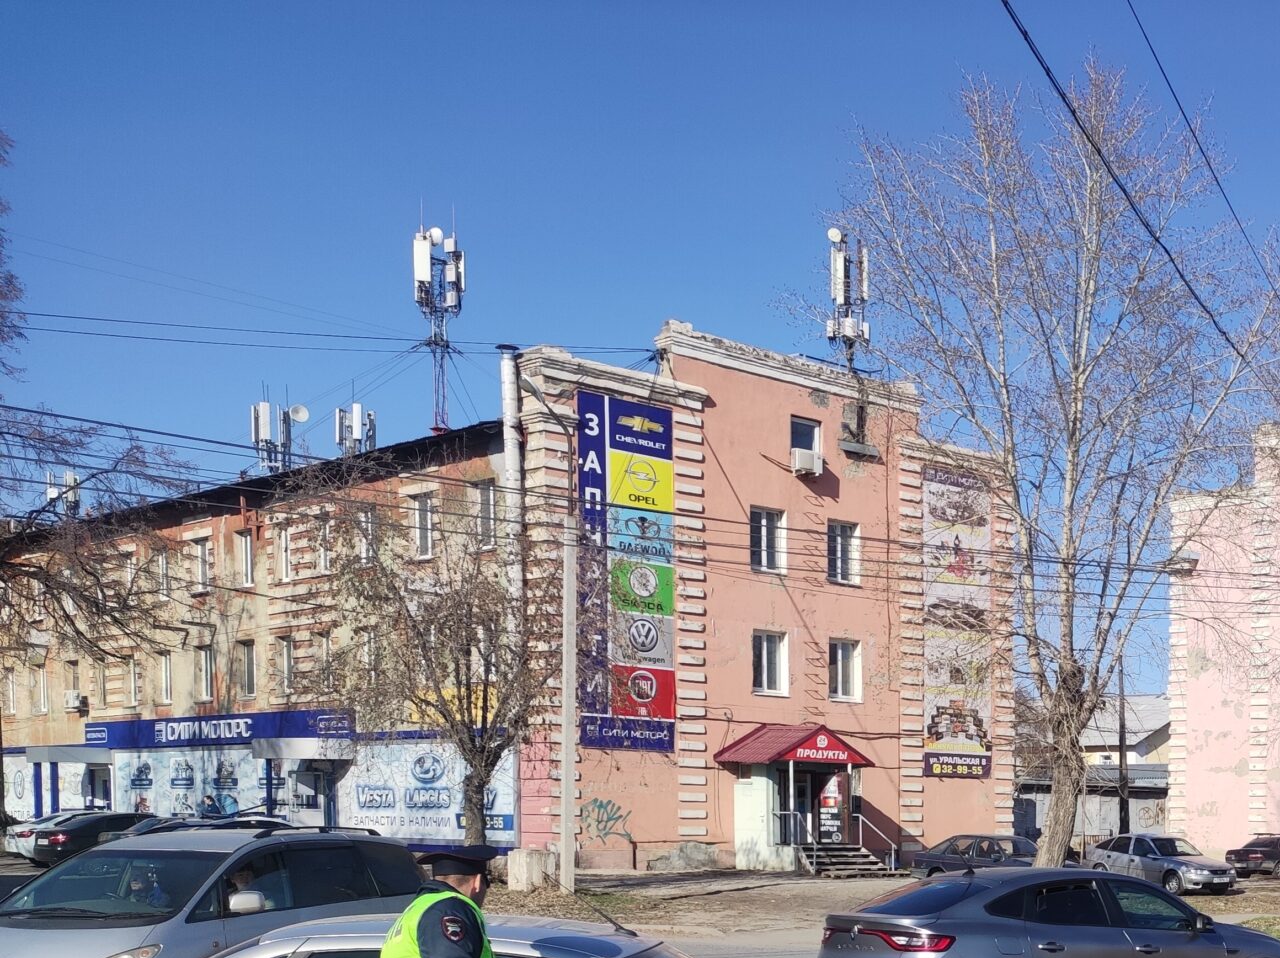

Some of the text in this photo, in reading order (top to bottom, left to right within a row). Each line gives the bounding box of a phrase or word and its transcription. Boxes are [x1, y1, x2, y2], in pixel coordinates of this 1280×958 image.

[615, 434, 667, 450] CHEVROLET
[628, 494, 658, 506] OPEL
[619, 541, 666, 556] DAEWOO
[167, 718, 253, 741] СИТИ МОТОРС
[602, 728, 669, 740] СИТИ МОТОРС
[796, 748, 848, 760] ПРОДУКТЫ
[941, 764, 983, 775] 32-99-55
[356, 786, 396, 809] VESTA
[404, 788, 451, 809] LARGUS
[353, 815, 450, 828] ЗАПЧАСТИ В НАЛИЧИИ
